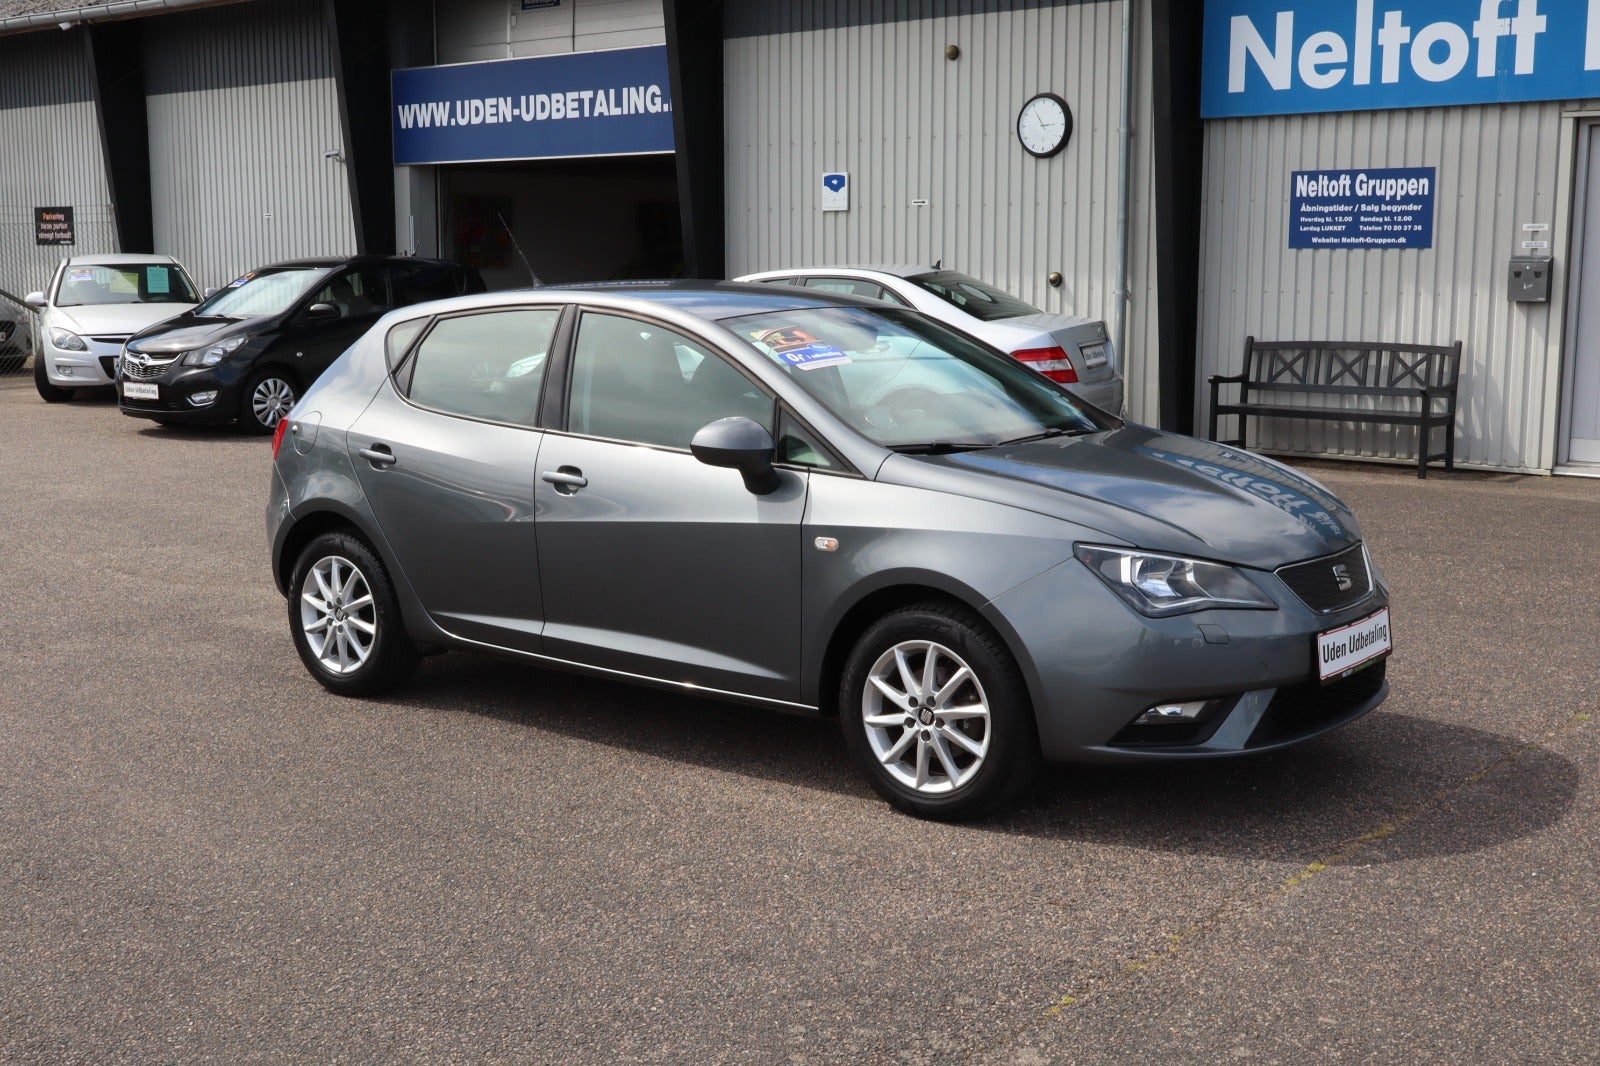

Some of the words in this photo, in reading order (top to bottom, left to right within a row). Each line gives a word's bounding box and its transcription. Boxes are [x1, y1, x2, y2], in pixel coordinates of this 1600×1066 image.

[1228, 0, 1547, 93] Neltoft
[398, 84, 672, 129] WWW.UDEN-UDBETALING.
[1296, 174, 1351, 197] Neltoft
[1355, 173, 1429, 200] Gruppen
[1300, 202, 1353, 213] Åbningstider
[1360, 204, 1379, 213] Salg
[1381, 203, 1423, 213] begynder
[1311, 236, 1340, 244] Website:
[1341, 237, 1407, 245] Neltoft-Gruppen.dk
[1322, 641, 1347, 664] Uden
[1349, 623, 1388, 654] Udbetaling
